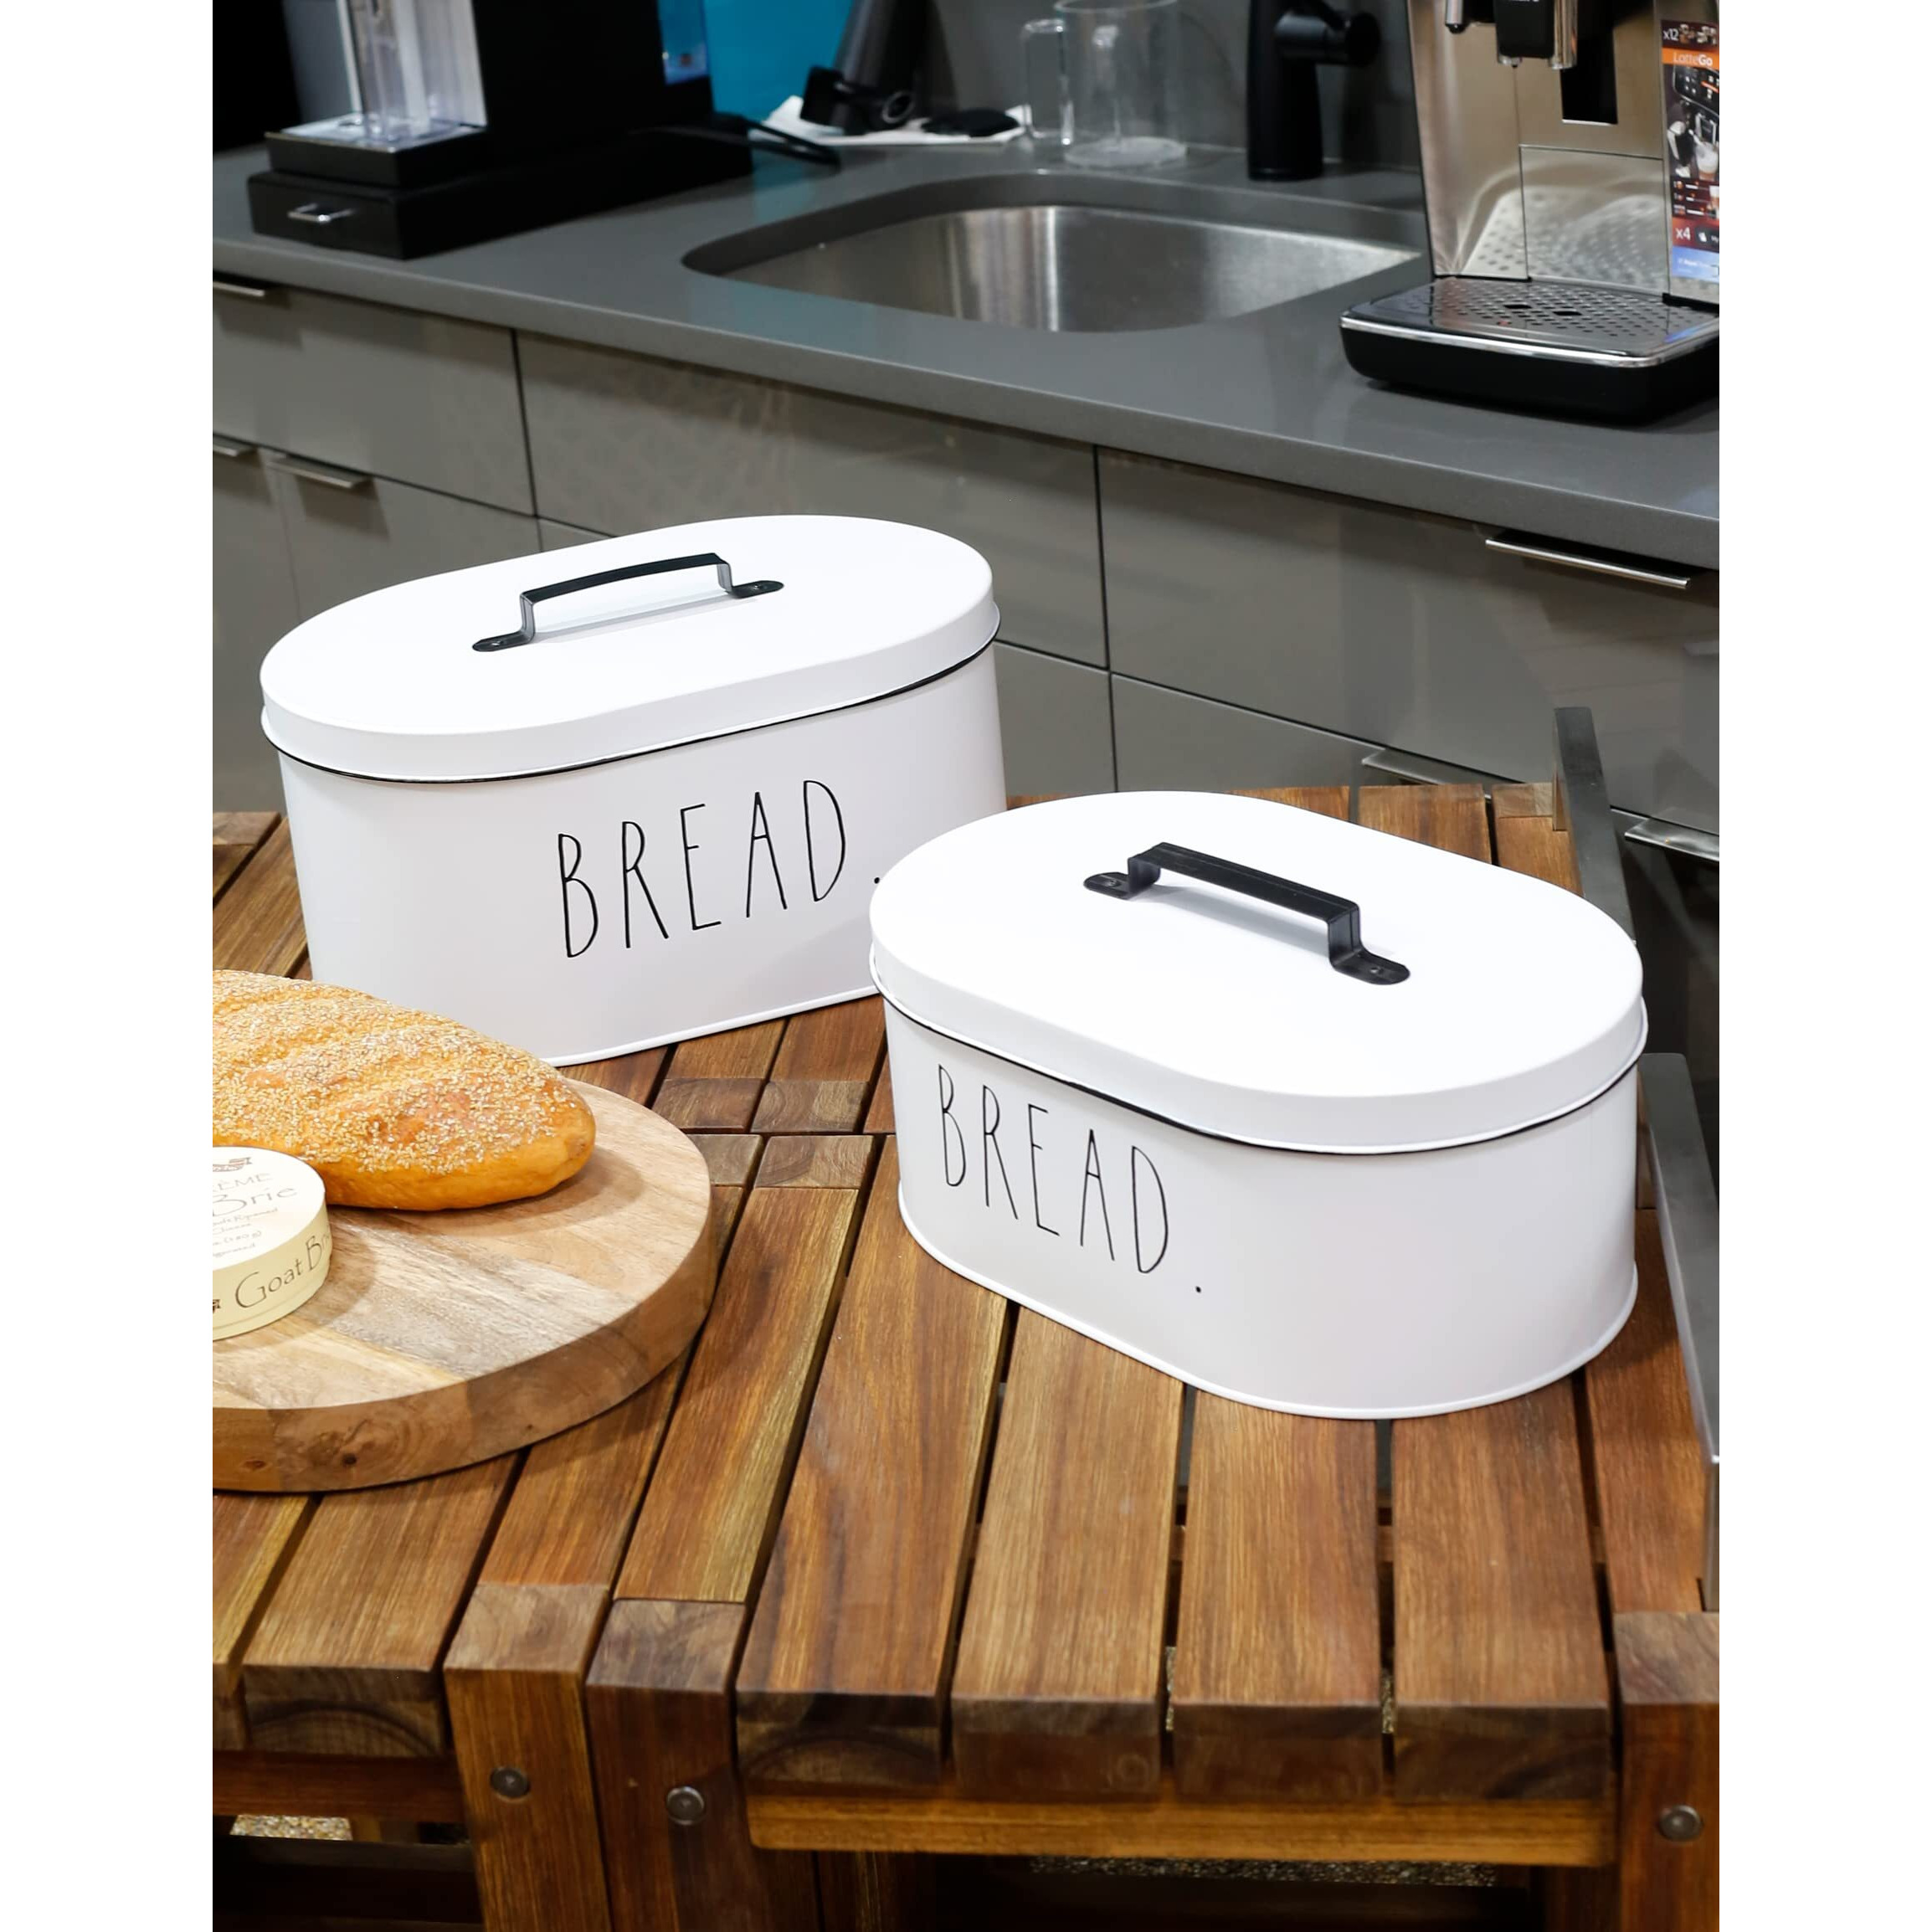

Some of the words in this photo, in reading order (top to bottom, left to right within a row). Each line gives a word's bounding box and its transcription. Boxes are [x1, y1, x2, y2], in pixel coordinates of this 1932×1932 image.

[1663, 28, 1679, 42] x12
[1673, 52, 1714, 67] LatteGo
[1675, 227, 1691, 241] x4
[235, 1258, 303, 1308] Goat
